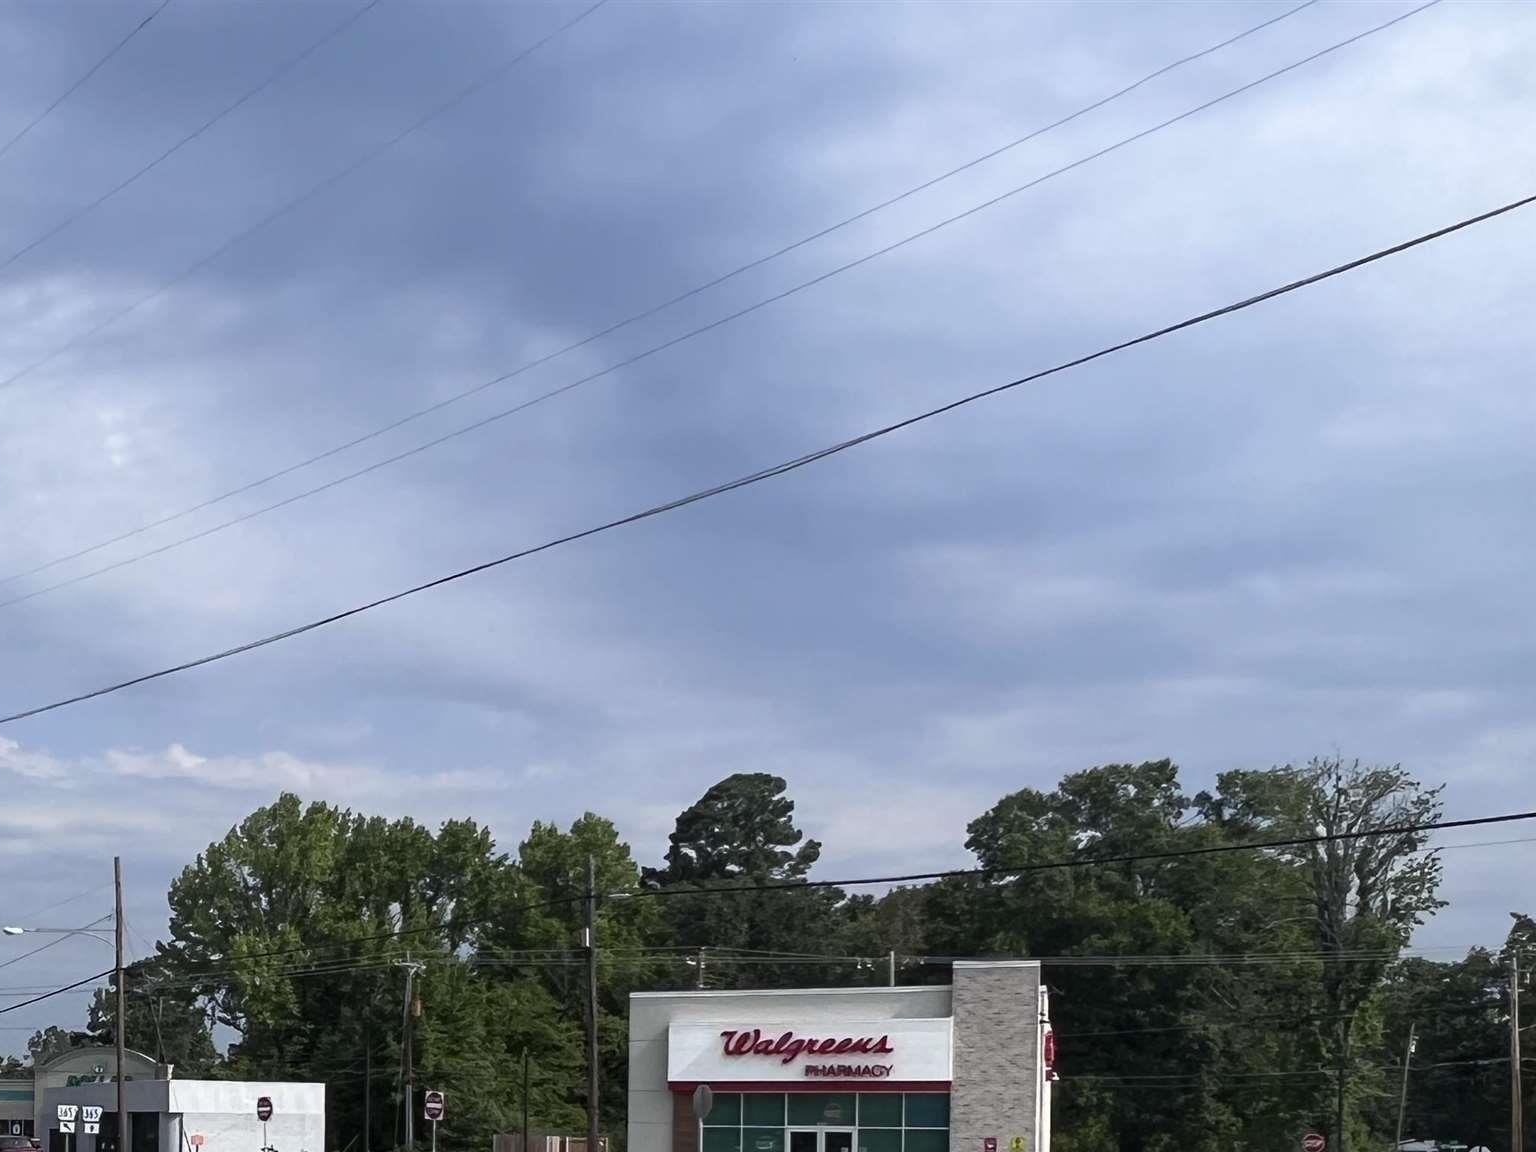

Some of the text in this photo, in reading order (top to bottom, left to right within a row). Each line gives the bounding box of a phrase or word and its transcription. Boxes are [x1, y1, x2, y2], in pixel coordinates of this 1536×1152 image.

[720, 1028, 894, 1065] Walgreens
[804, 1064, 894, 1077] PHARMACY
[58, 1107, 74, 1119] 365
[84, 1108, 99, 1119] 365
